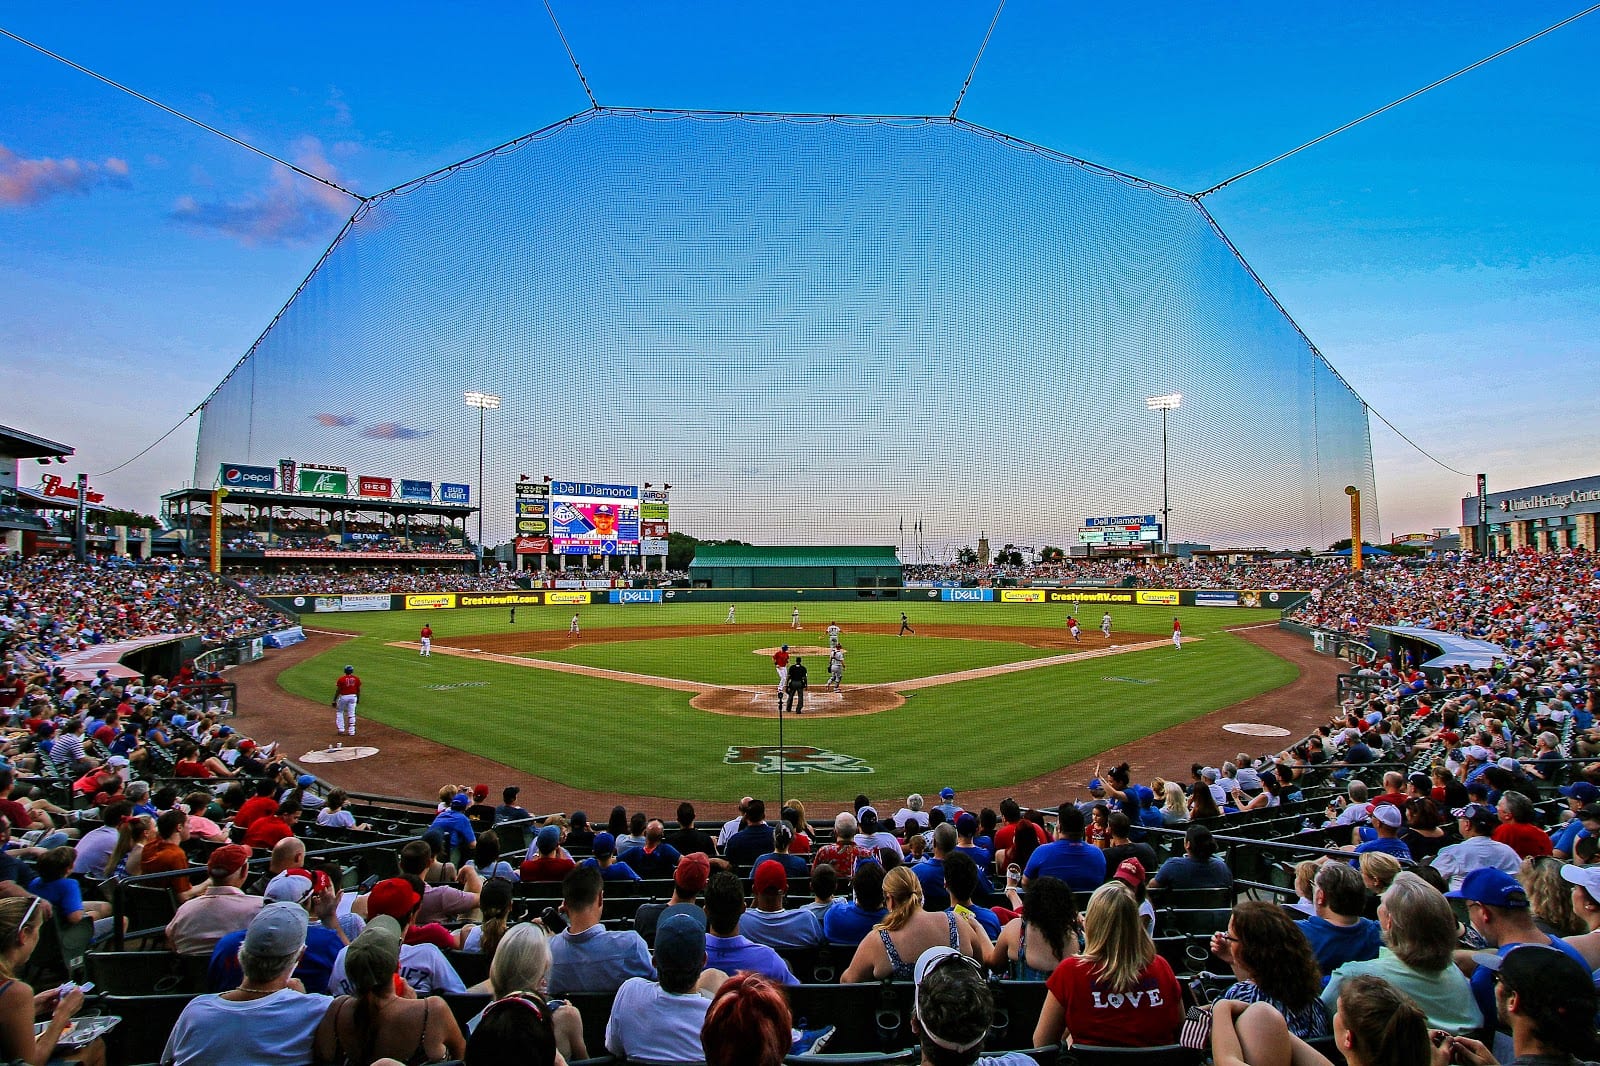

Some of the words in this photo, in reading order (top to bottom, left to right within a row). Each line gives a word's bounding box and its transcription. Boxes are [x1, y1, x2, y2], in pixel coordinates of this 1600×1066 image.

[242, 473, 271, 483] pepsi
[447, 486, 464, 494] BUD
[559, 482, 581, 495] Dell
[585, 484, 632, 497] Diamond
[1509, 495, 1535, 511] United
[1534, 492, 1571, 509] Heritage
[1110, 517, 1145, 525] Diamond
[461, 595, 539, 605] CrestviewRV.com
[623, 591, 650, 601] DELL
[954, 590, 980, 600] DELL
[1051, 592, 1132, 602] CrestviewRV.com
[1091, 988, 1164, 1009] LOVE
